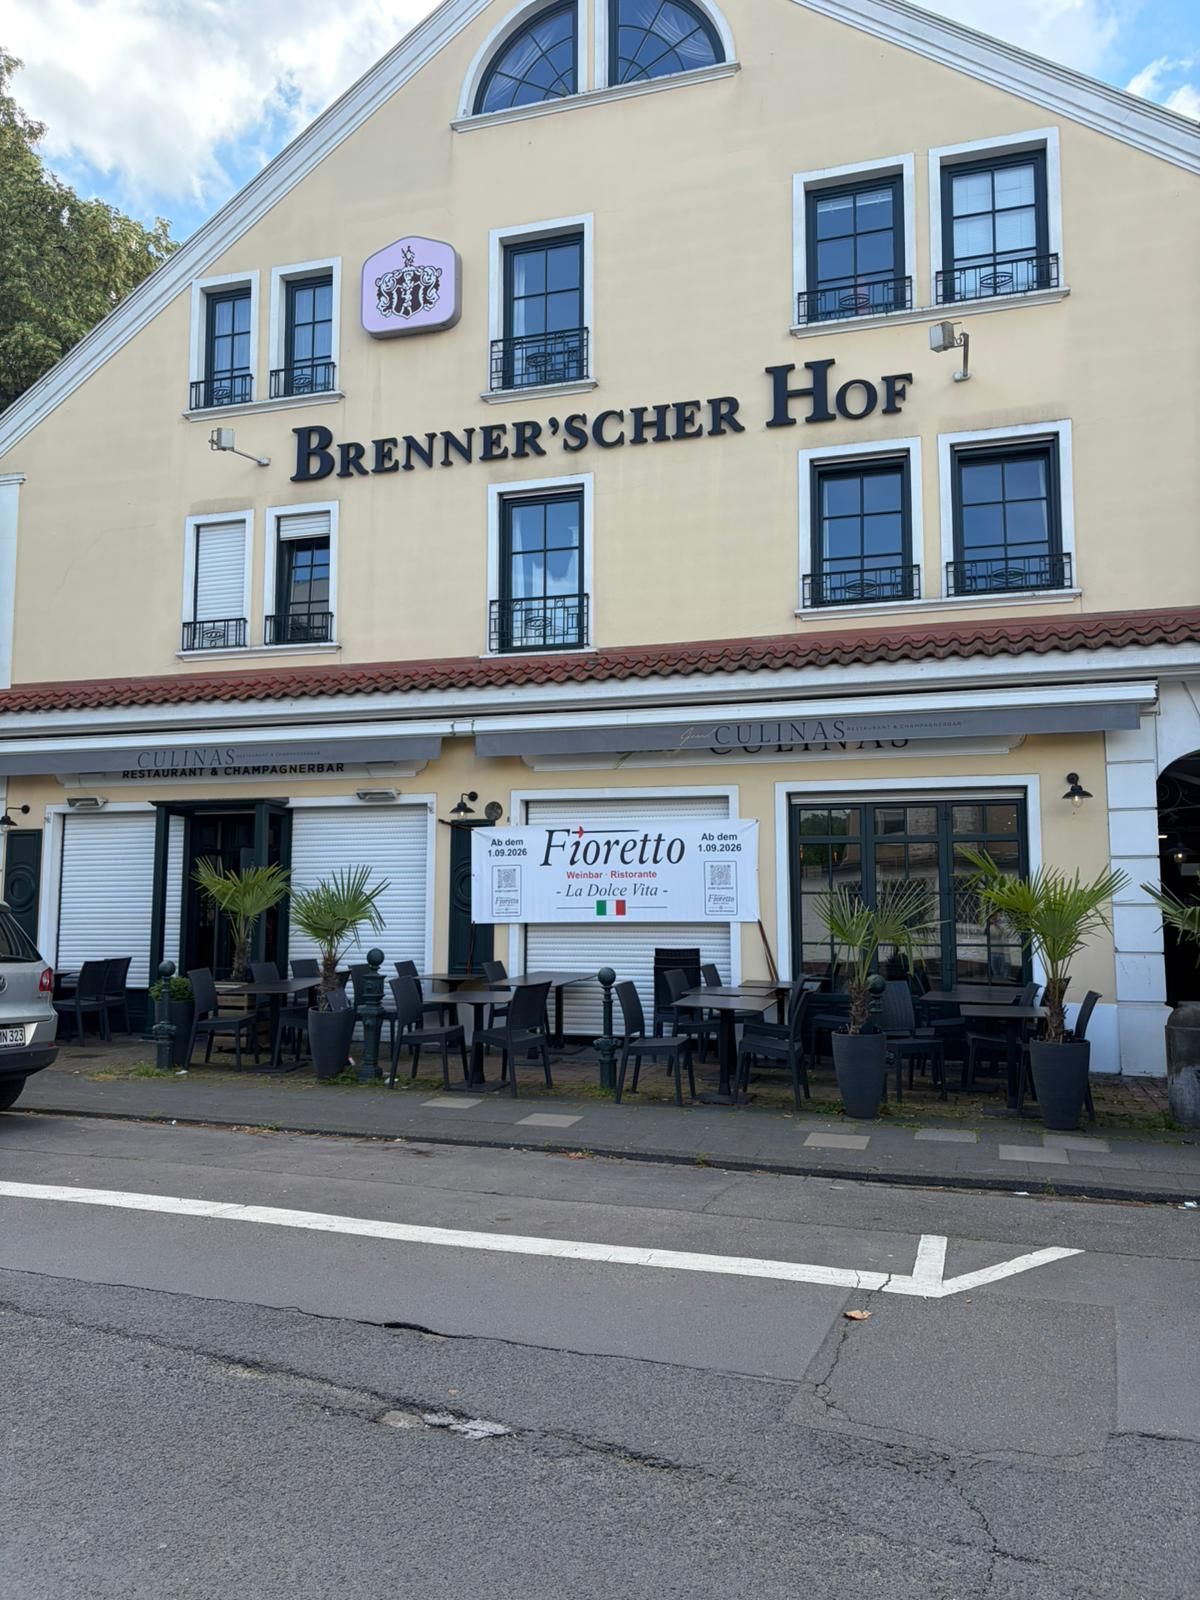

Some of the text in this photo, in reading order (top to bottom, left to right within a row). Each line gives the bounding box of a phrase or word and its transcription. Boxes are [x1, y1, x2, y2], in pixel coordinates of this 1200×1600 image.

[765, 358, 914, 428] HOF
[715, 720, 846, 744] CULINAS
[137, 749, 235, 768] CULINAS
[122, 763, 345, 779] RESTAURANT & CHAMPAGNERBAR
[490, 838, 524, 847] Ab dem
[701, 833, 738, 842] Ab dem
[488, 848, 528, 857] 1.09.2026
[539, 829, 686, 867] Fioretto
[698, 844, 742, 852] 1.09.2026
[566, 870, 603, 880] Weinbar
[610, 870, 657, 880] Ristorante
[566, 884, 583, 897] La
[587, 884, 628, 898] Dolce
[632, 883, 659, 897] Vita
[9, 1029, 24, 1042] 323
